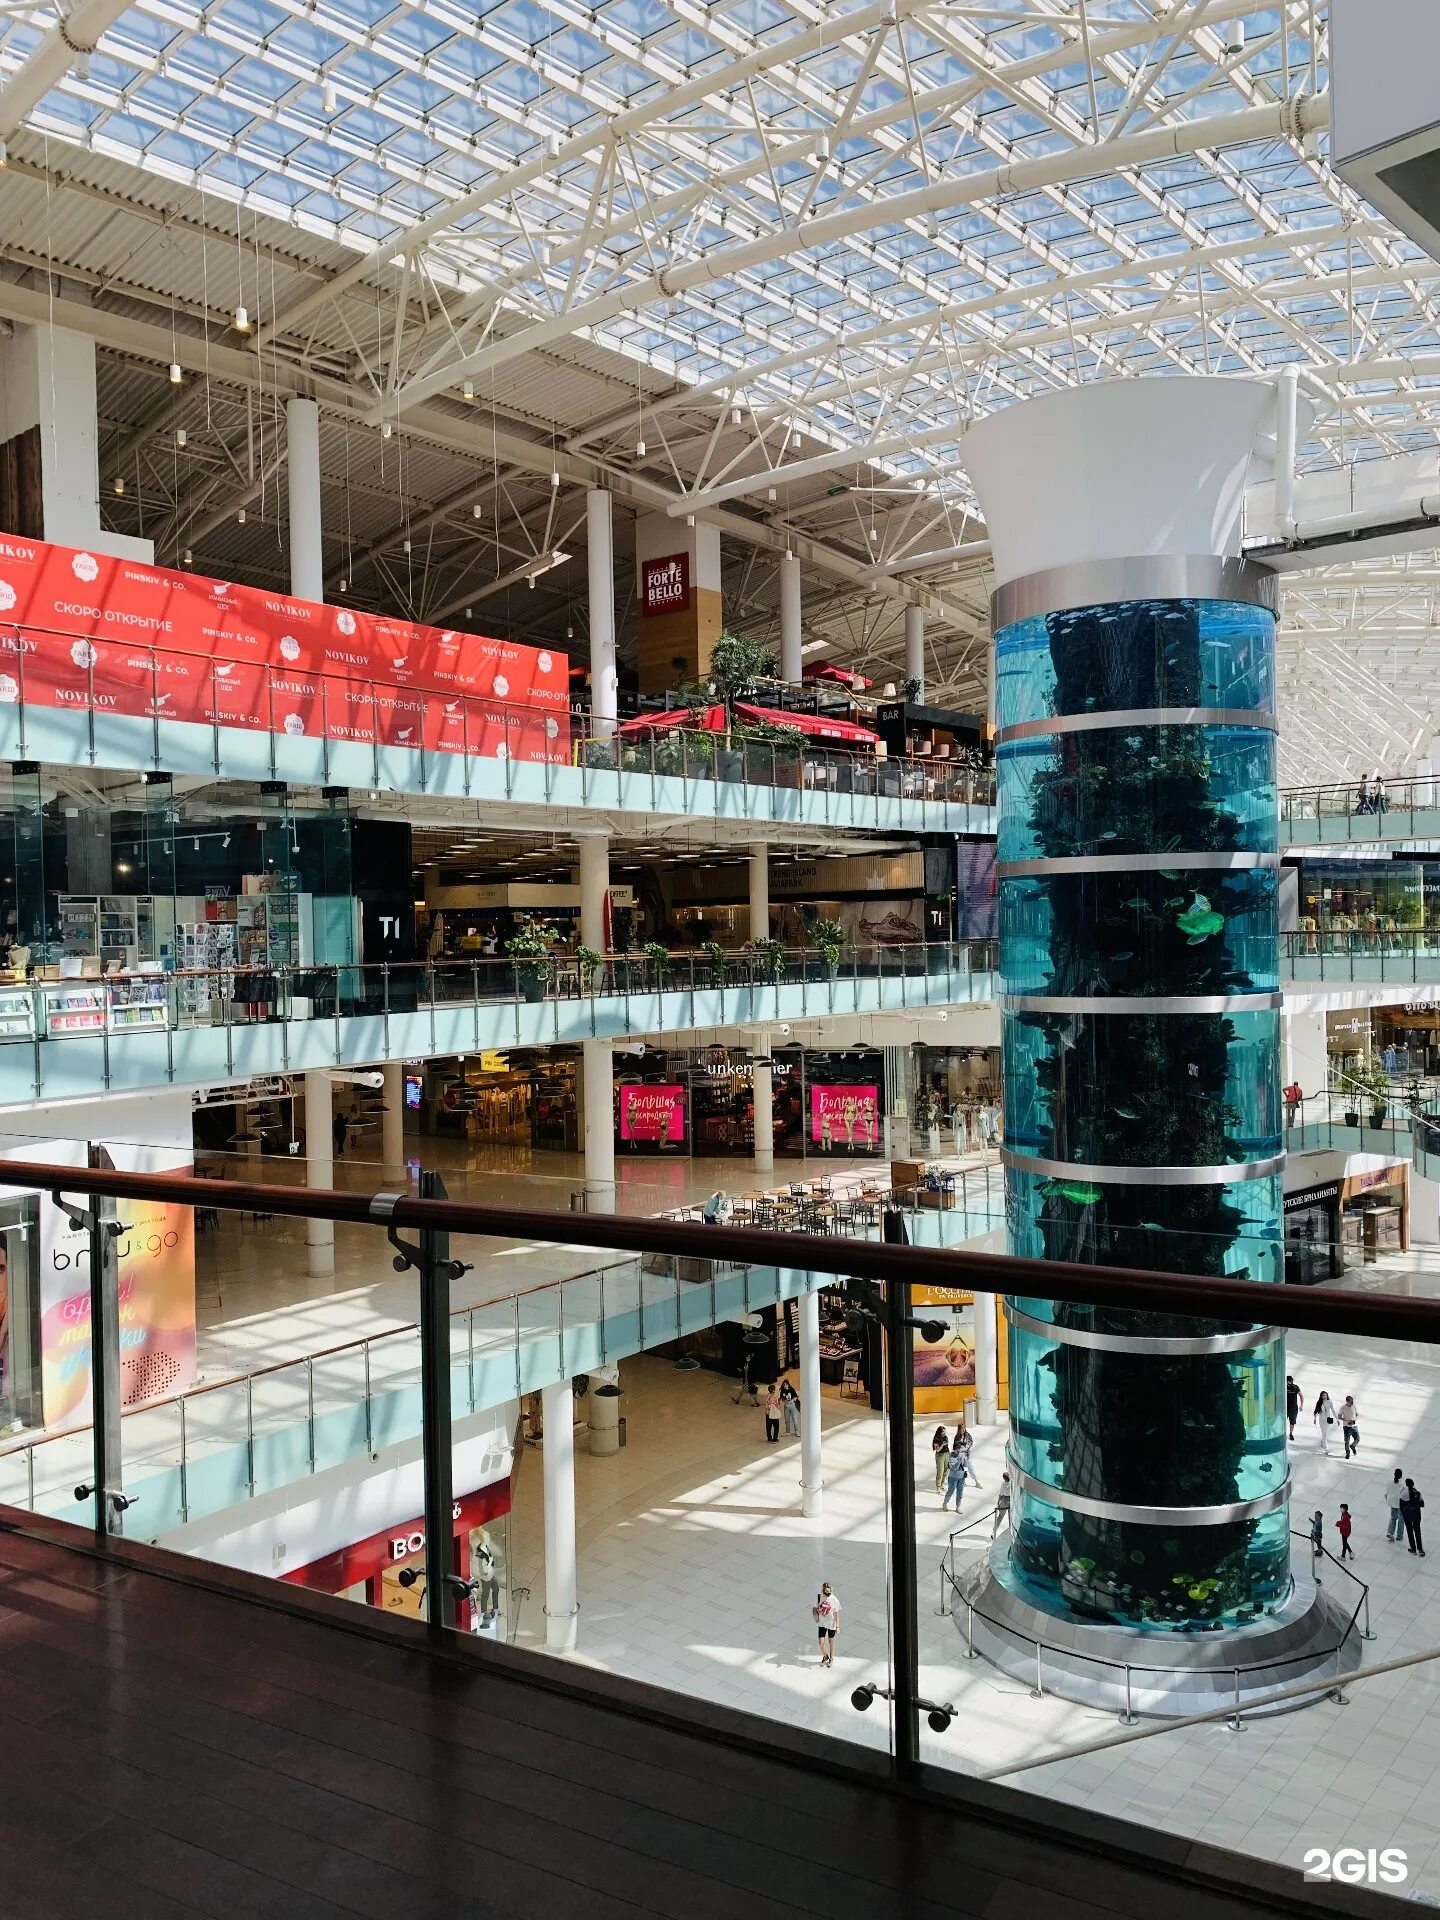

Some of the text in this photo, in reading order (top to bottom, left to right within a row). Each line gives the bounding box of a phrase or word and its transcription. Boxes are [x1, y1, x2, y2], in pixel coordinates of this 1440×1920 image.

[648, 568, 682, 588] FORTE
[648, 583, 682, 601] BELLO
[54, 601, 173, 632] СКОРО ОТКРЫТИЕ
[265, 600, 312, 618] NOVIKOV
[325, 649, 369, 665] NOVIKOV
[482, 645, 519, 659] NOVIKOV
[526, 687, 553, 699] СКОРО
[344, 692, 429, 713] СКОРО ОТКРЫТИЕ
[882, 710, 899, 720] BAR
[329, 724, 375, 740] NOVIKOV
[1405, 1002, 1427, 1012] OTTO
[146, 1231, 179, 1258] go
